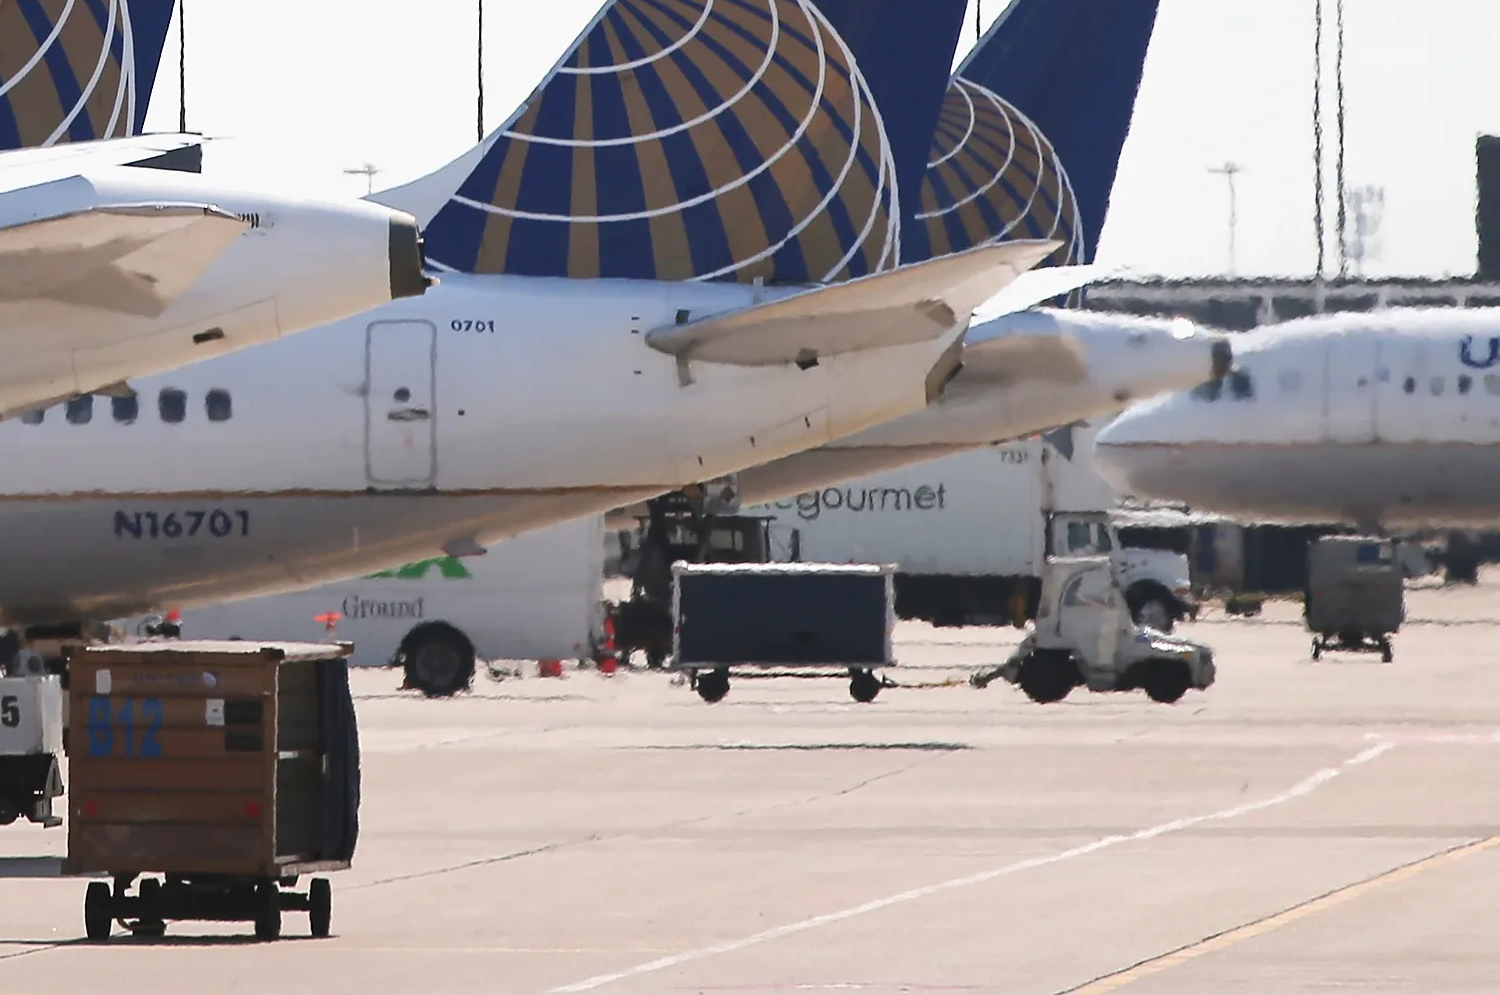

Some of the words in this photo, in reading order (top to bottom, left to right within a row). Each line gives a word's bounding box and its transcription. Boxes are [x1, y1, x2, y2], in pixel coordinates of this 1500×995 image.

[450, 318, 495, 334] 0701
[752, 483, 946, 520] gourmet
[113, 508, 251, 539] N16701
[342, 593, 424, 619] Ground
[88, 696, 164, 758] B12
